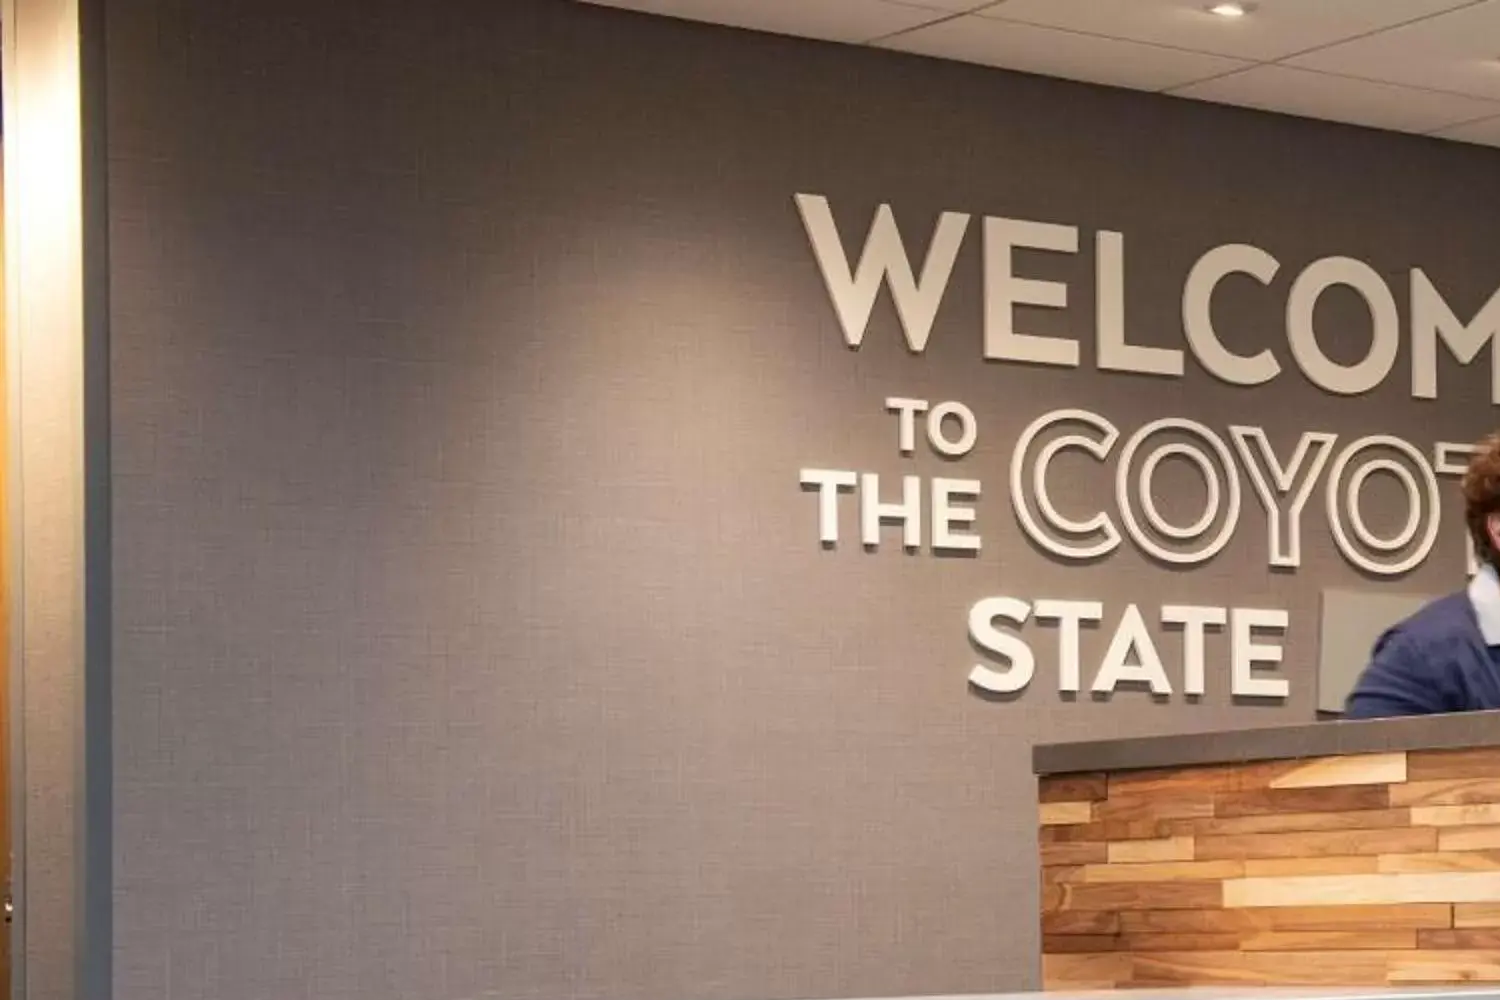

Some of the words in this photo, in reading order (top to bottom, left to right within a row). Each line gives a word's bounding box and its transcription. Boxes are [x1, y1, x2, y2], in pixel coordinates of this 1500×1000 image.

[885, 397, 978, 457] TO
[800, 469, 982, 550] THE
[1009, 408, 1492, 576] COYO
[967, 596, 1290, 698] STATE
